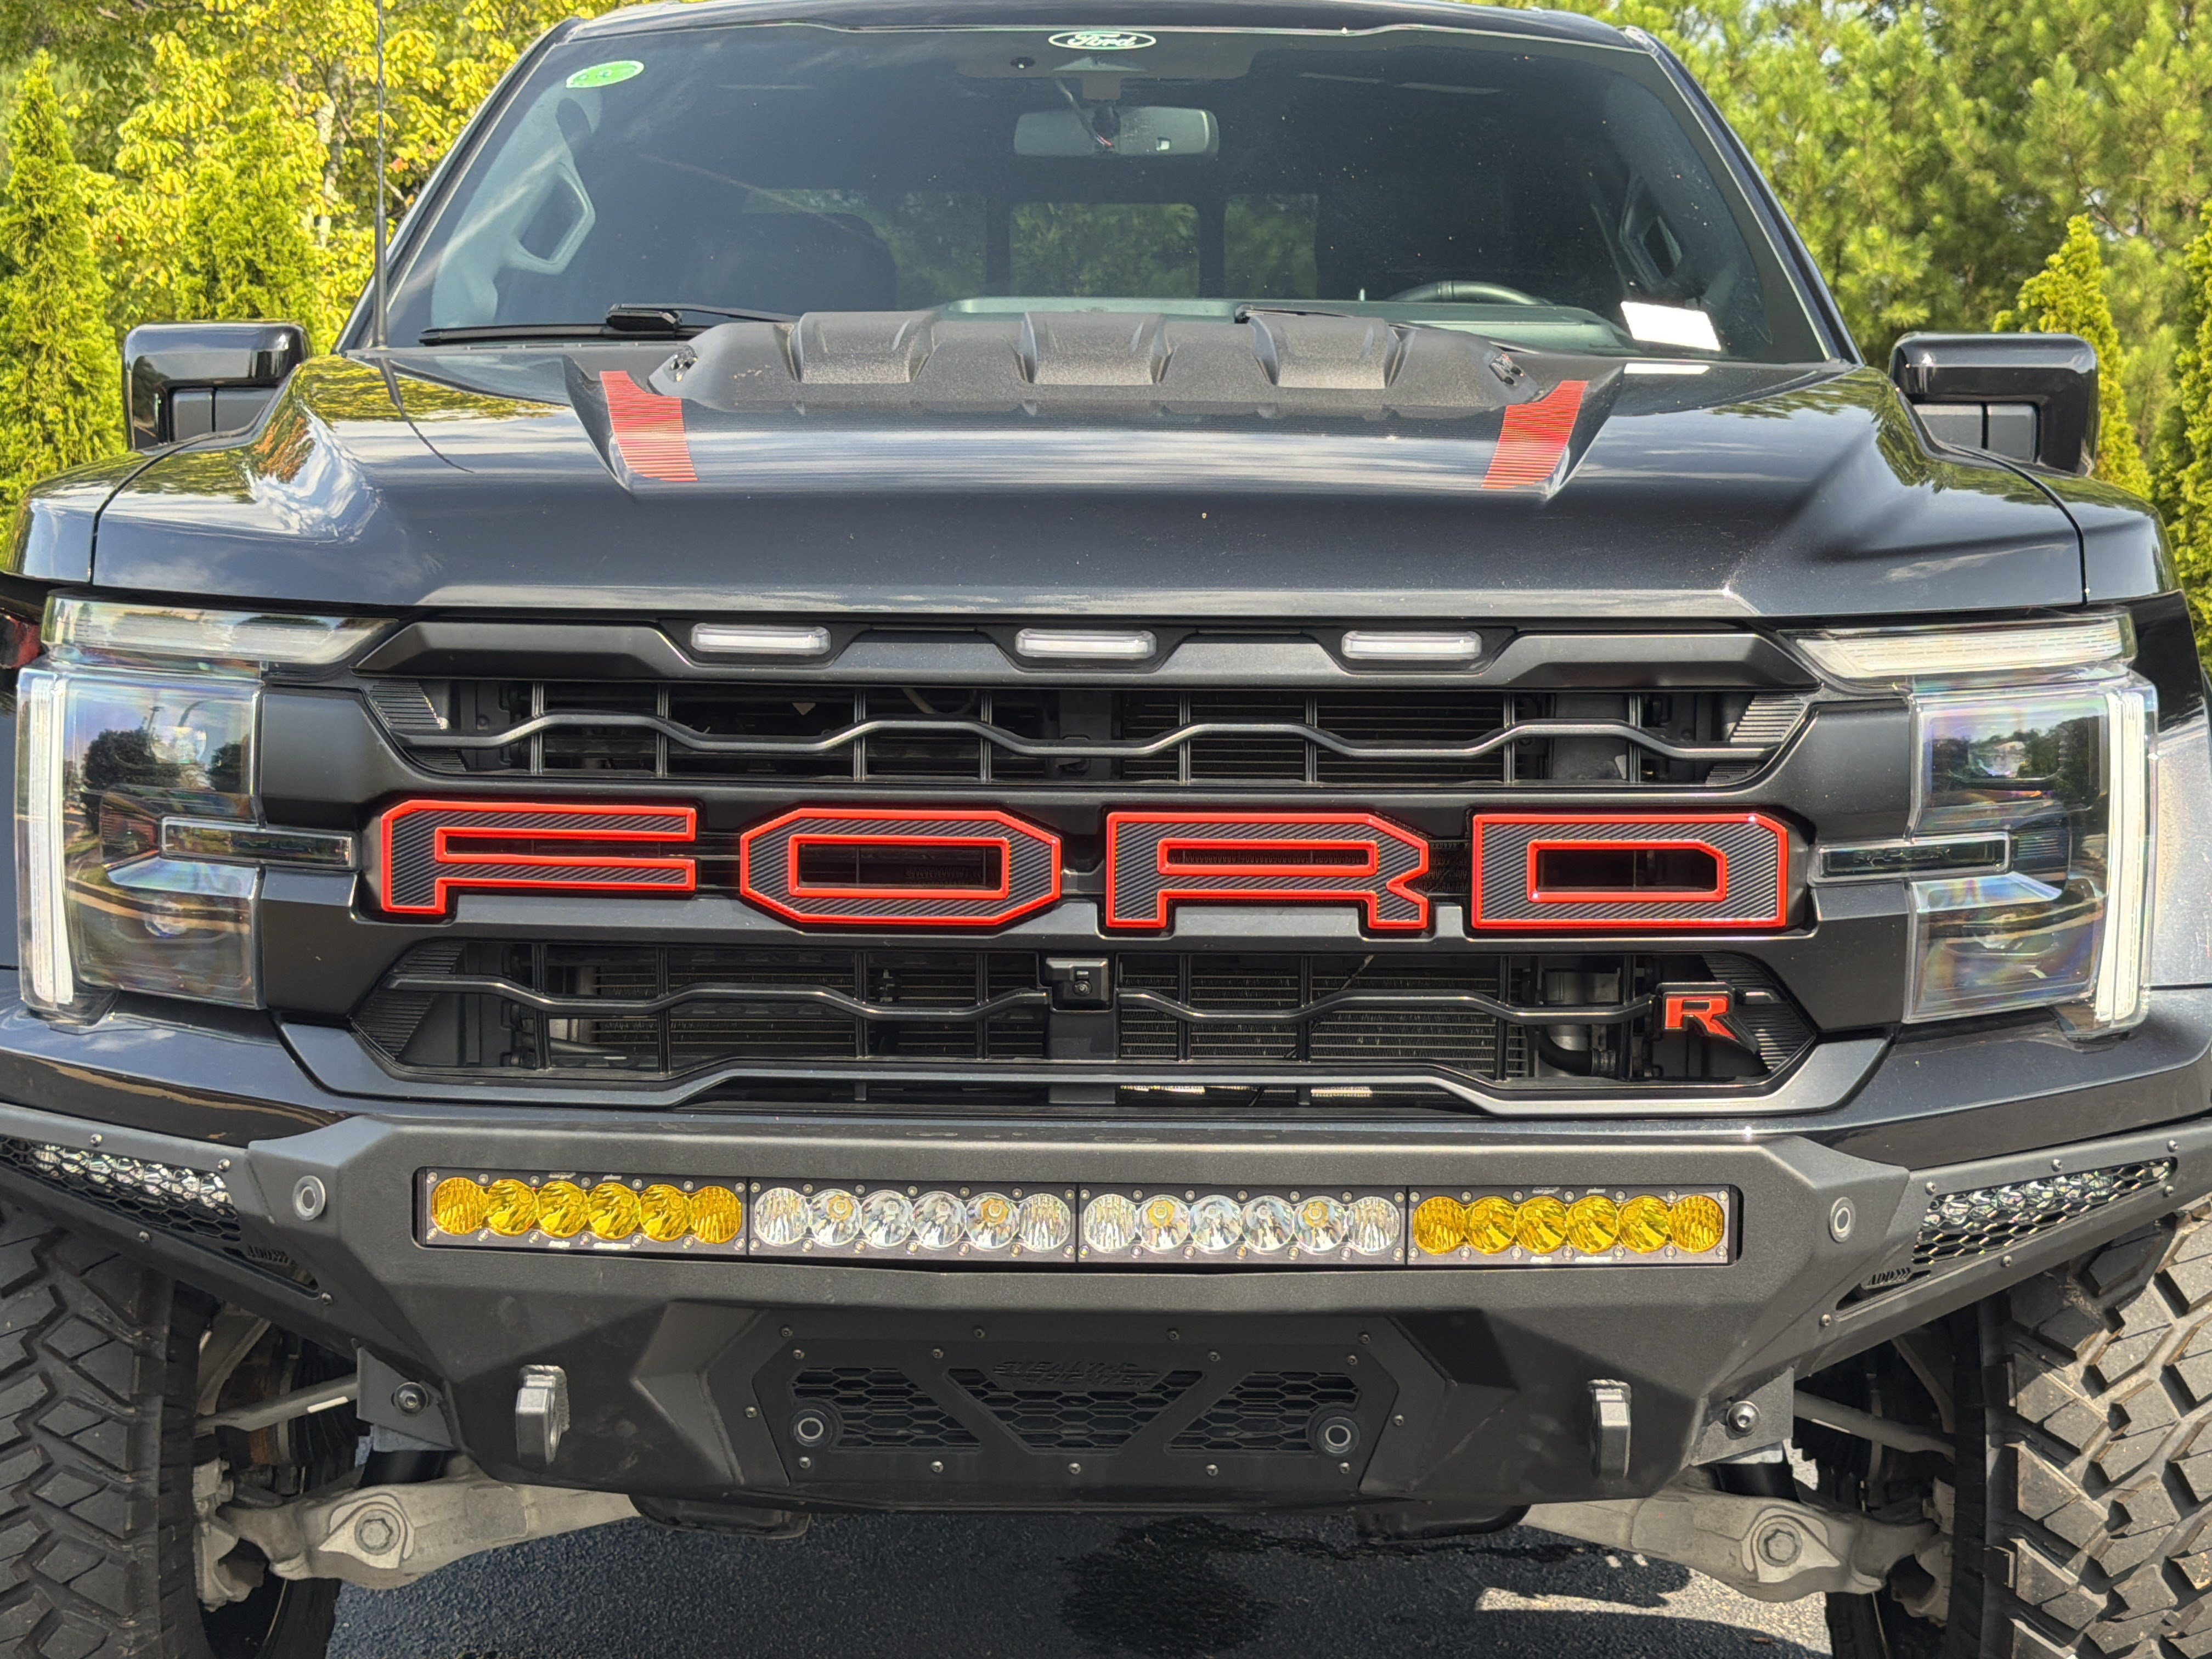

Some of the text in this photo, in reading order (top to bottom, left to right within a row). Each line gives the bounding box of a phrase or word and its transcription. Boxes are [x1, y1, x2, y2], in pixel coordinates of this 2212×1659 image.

[1068, 33, 1137, 47] Ford
[381, 799, 1788, 930] FORD
[1662, 992, 1742, 1042] R
